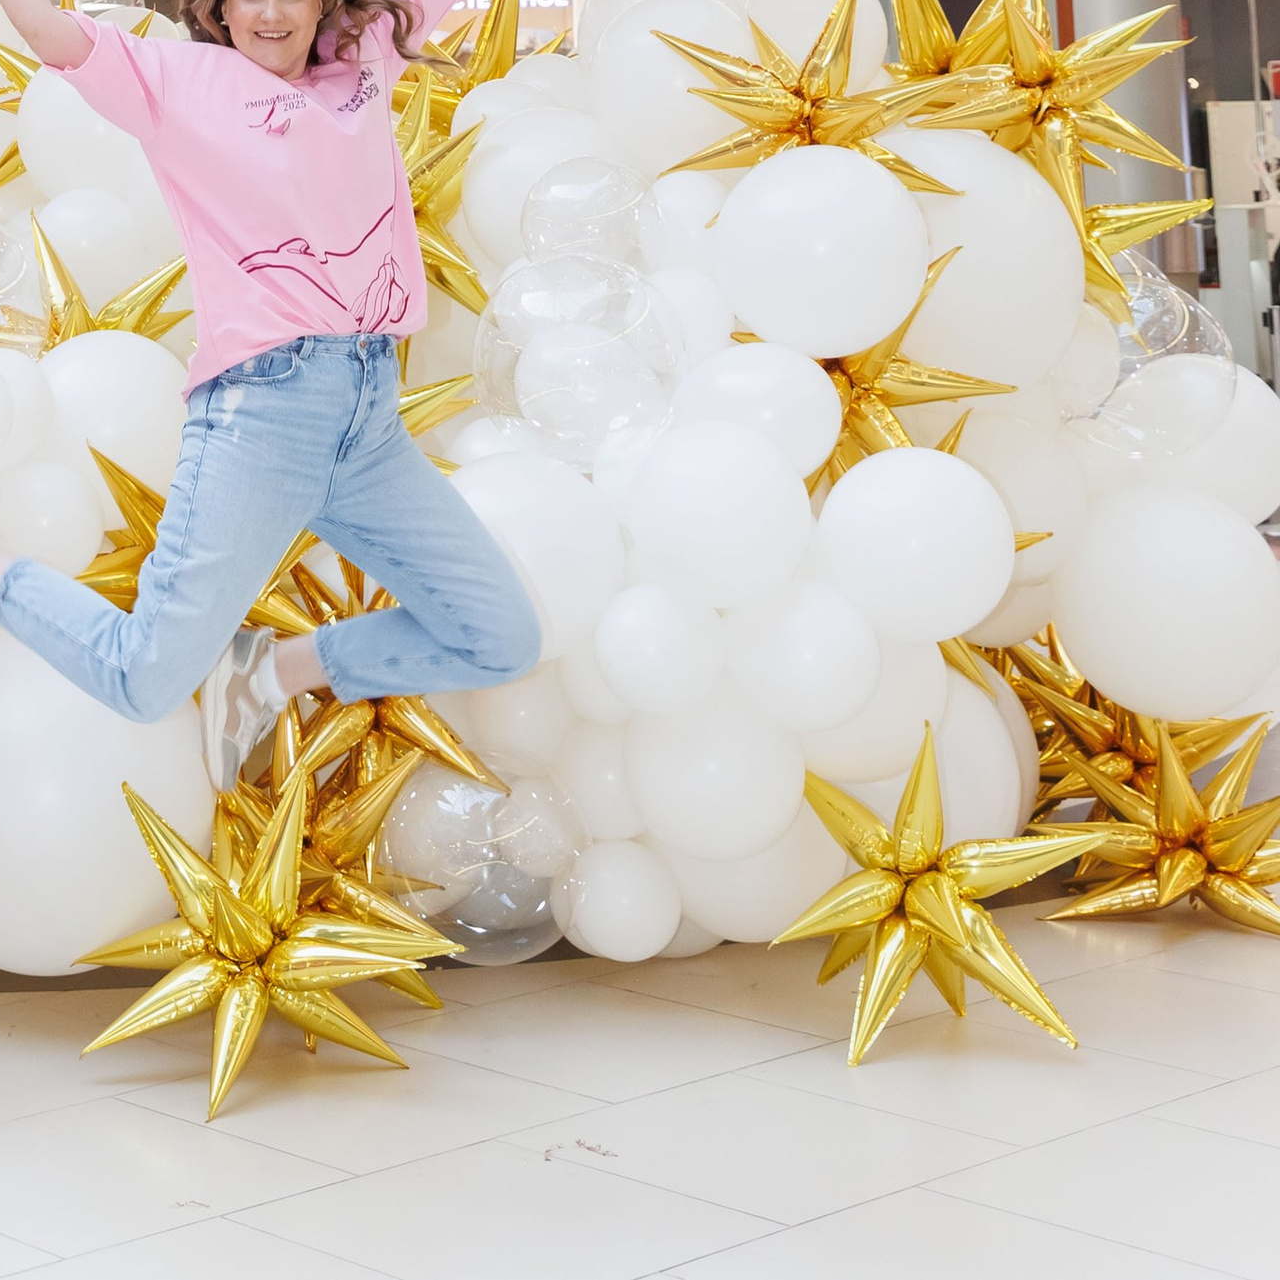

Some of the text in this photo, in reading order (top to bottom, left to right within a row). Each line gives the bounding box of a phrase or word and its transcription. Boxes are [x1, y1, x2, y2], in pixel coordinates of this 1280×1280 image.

[244, 92, 306, 110] УМНАЯ ВЕСНА
[283, 99, 307, 112] 2025
